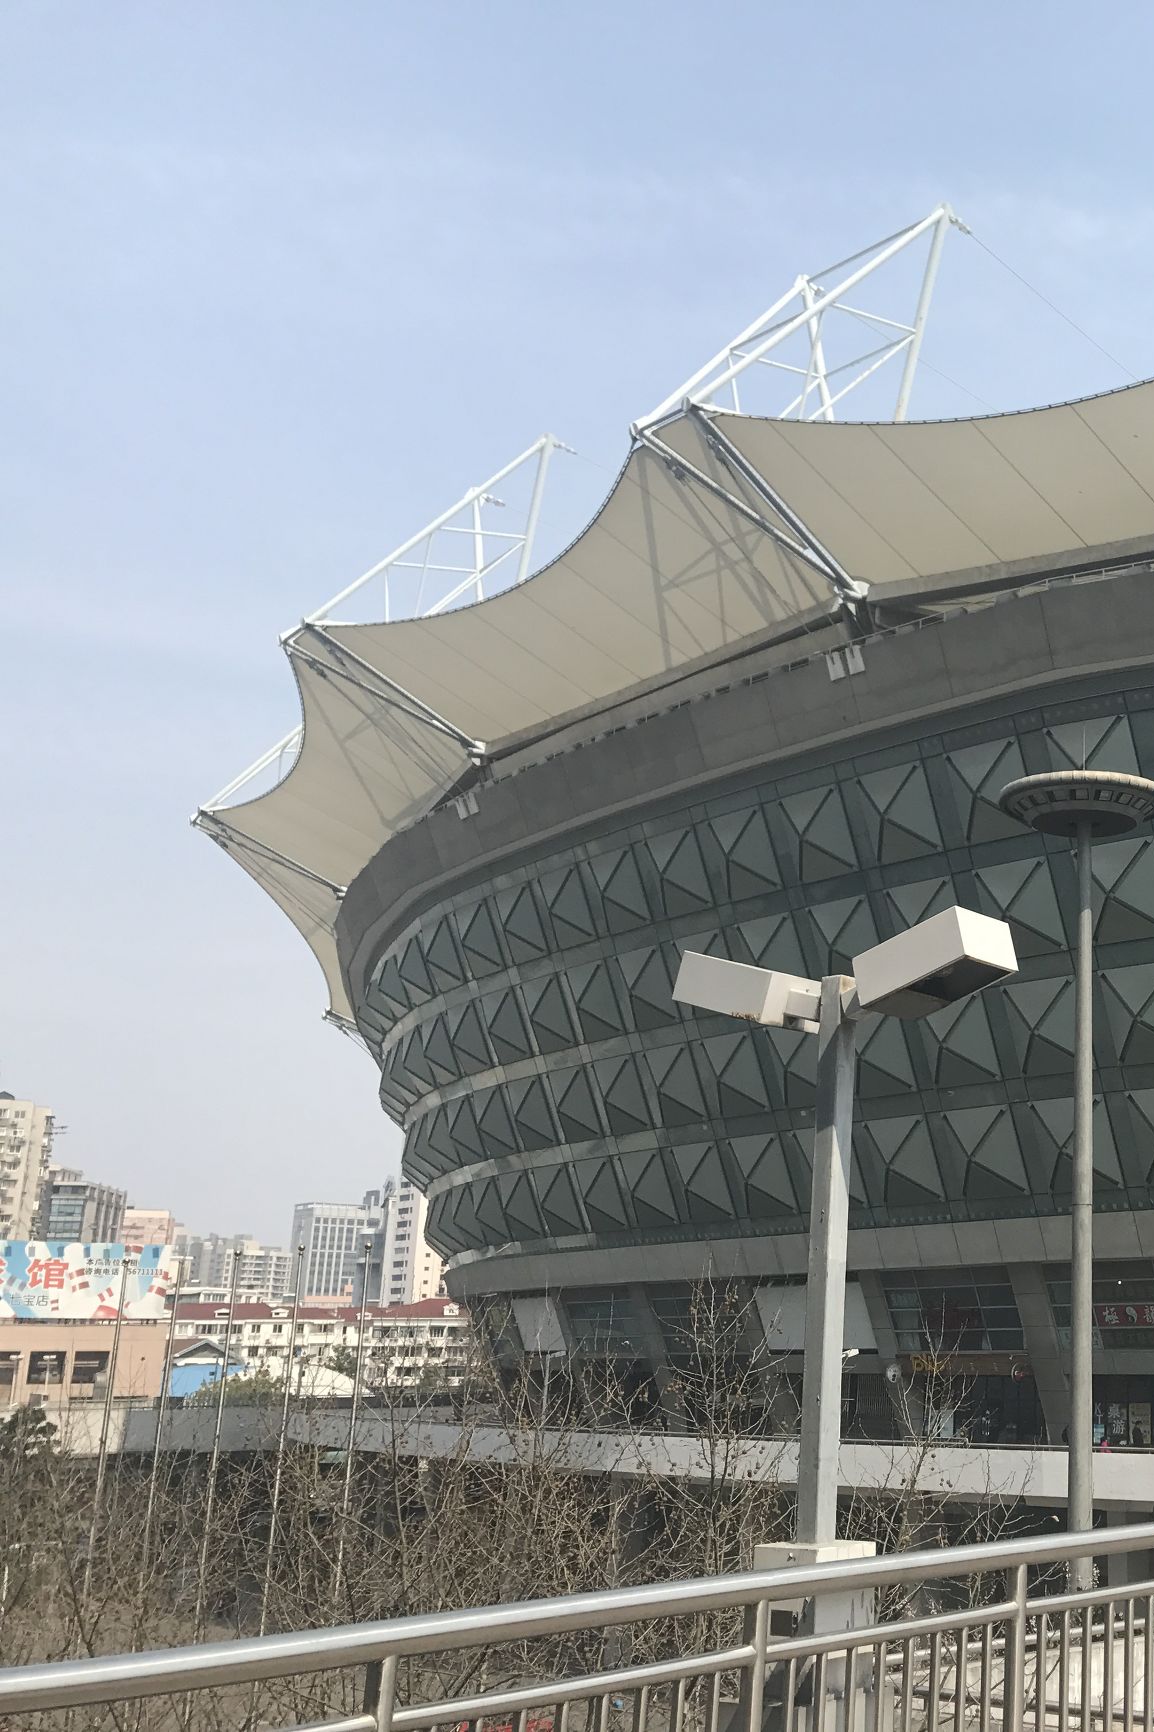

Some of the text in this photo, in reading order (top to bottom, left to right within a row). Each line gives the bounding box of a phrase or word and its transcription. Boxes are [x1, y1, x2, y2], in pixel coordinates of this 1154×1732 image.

[86, 1258, 138, 1267] 本广告位租
[85, 1268, 119, 1276] 咨询电话
[10, 1294, 49, 1307] 七宝店
